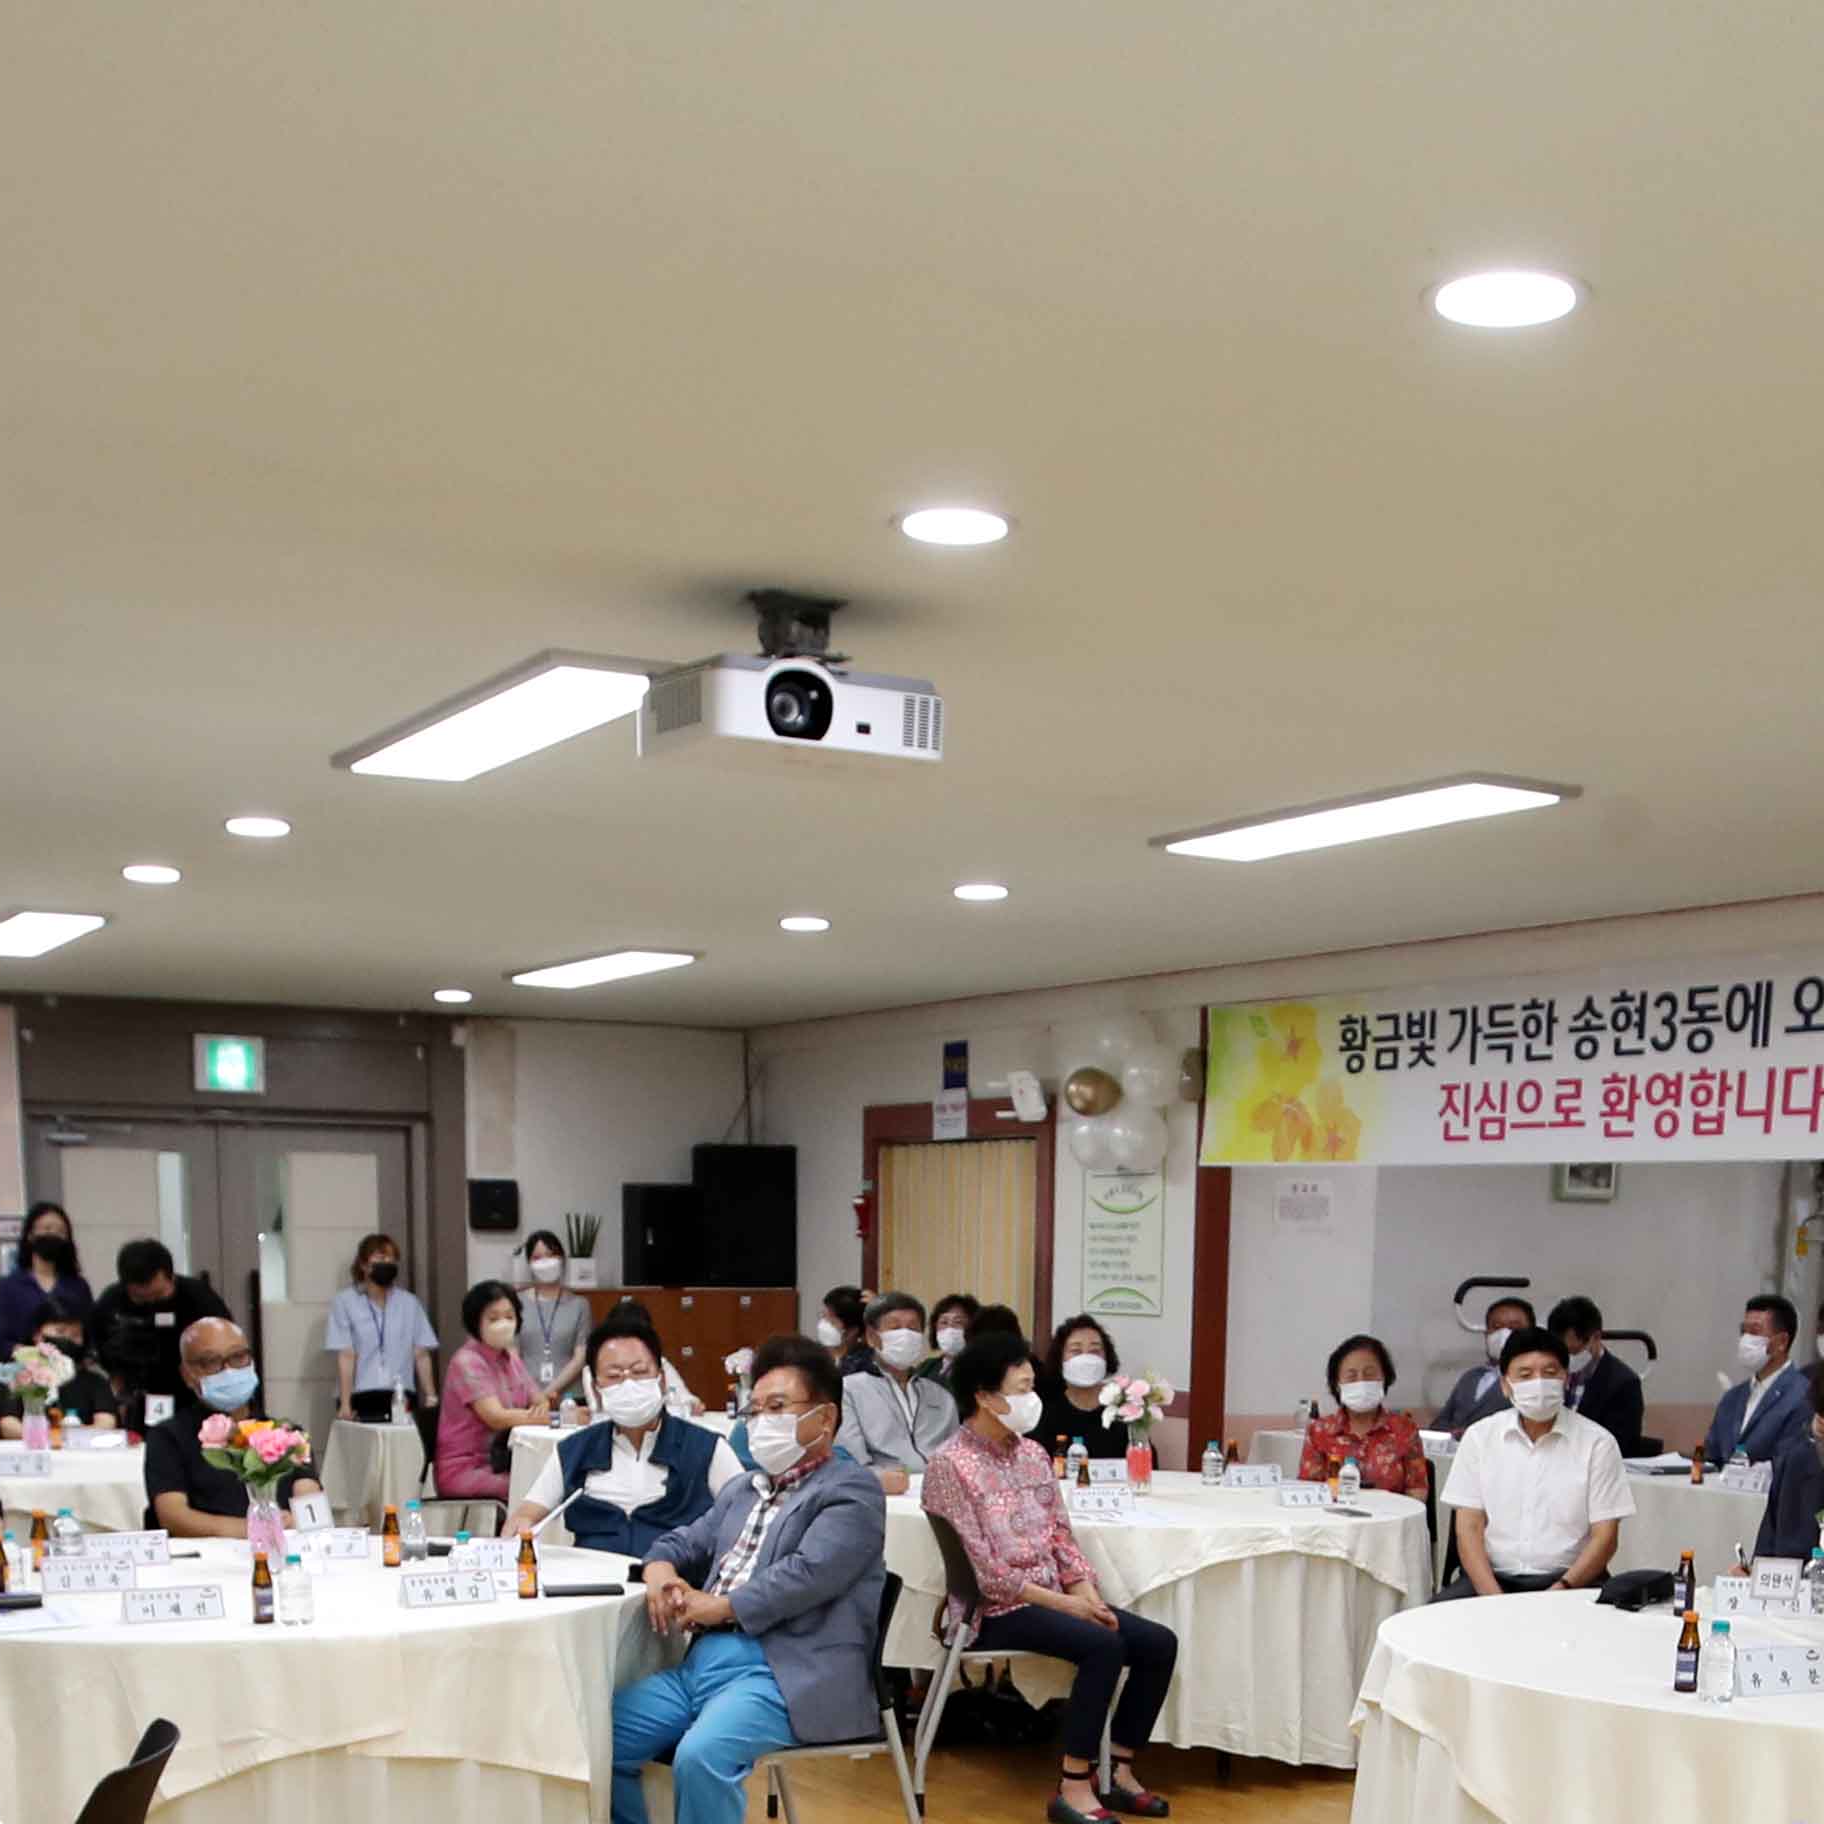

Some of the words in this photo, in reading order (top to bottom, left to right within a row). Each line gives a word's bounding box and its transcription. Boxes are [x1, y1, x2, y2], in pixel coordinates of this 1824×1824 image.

[1338, 1010, 1438, 1075] 황금빛
[1447, 998, 1559, 1065] 가득한
[1568, 979, 1774, 1061] 송현3동에
[1438, 1078, 1586, 1142] 진심으로
[304, 1502, 317, 1524] 1
